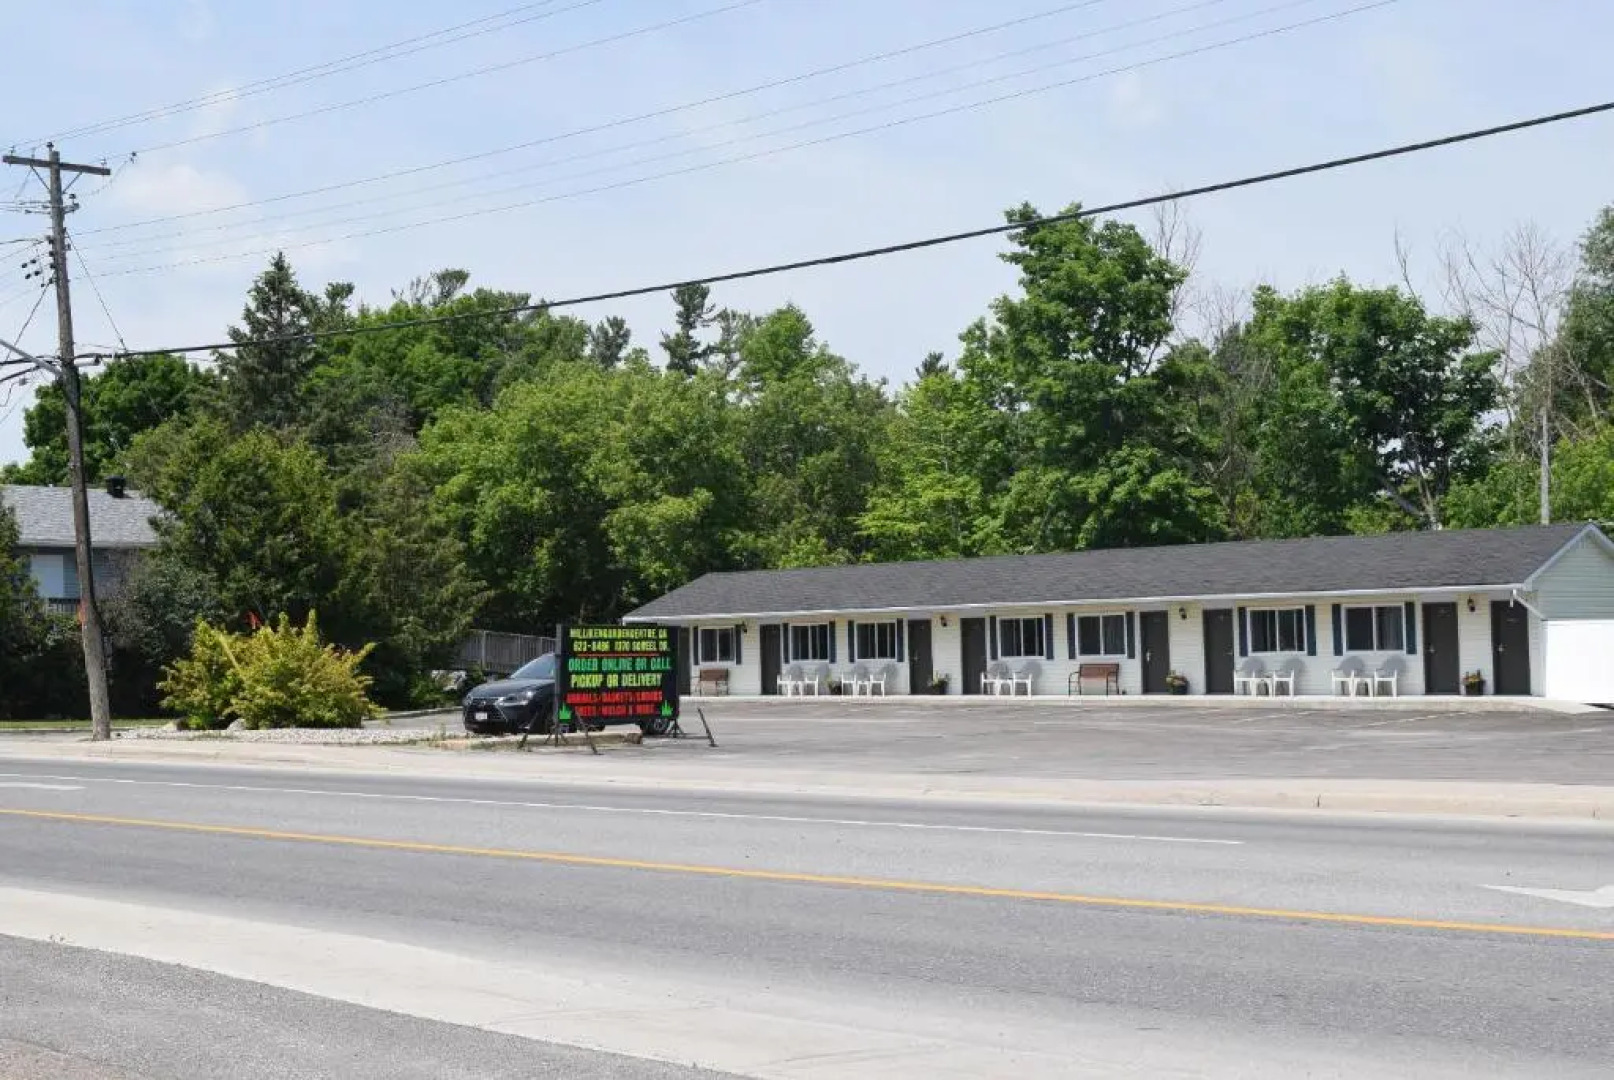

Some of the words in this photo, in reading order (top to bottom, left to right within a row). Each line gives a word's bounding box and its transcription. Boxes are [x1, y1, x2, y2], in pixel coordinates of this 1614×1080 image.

[568, 658, 598, 671] ORDER
[601, 658, 632, 671] ONLINE
[635, 658, 647, 671] OR
[650, 657, 671, 671] CALL
[570, 674, 603, 688] PICKUP
[606, 674, 619, 687] OR
[621, 673, 662, 687] DELIVERY
